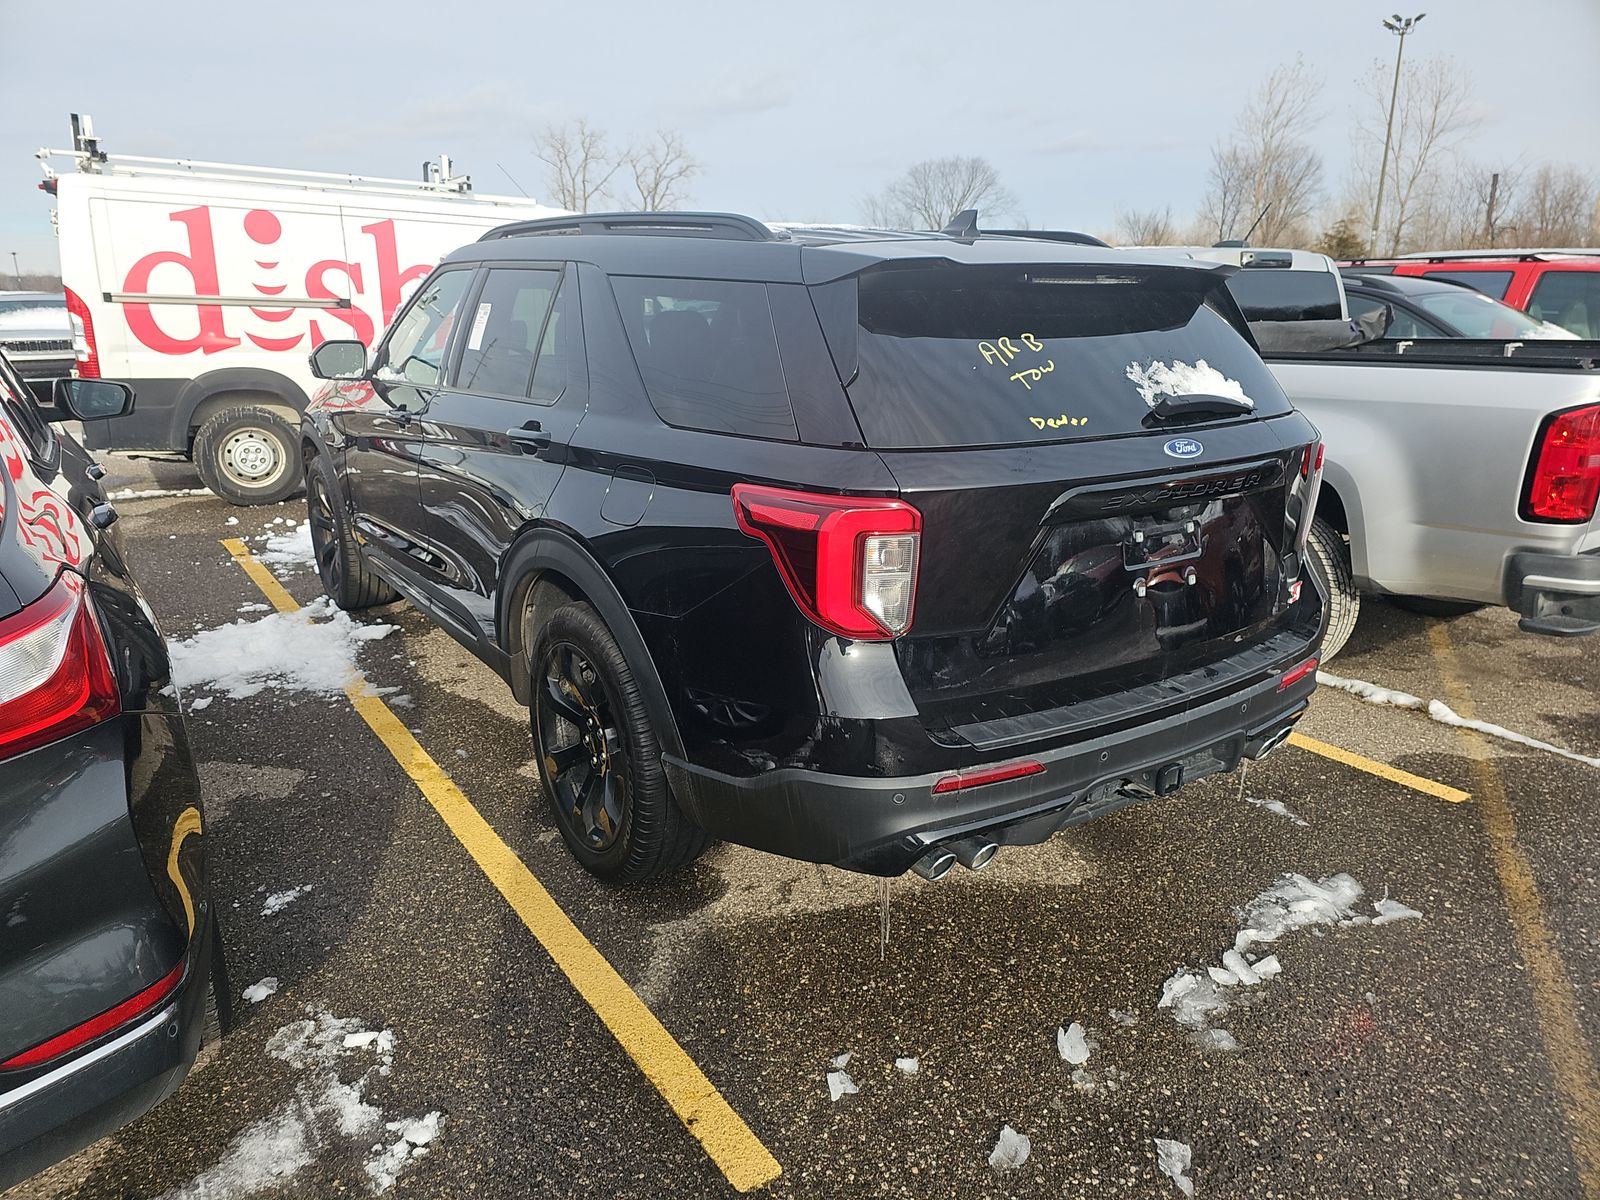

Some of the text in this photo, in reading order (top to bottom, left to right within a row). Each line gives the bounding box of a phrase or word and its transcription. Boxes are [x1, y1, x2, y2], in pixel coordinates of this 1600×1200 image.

[978, 333, 1044, 367] ARB
[1174, 441, 1197, 454] Ford
[1101, 473, 1262, 510] EXPLORER
